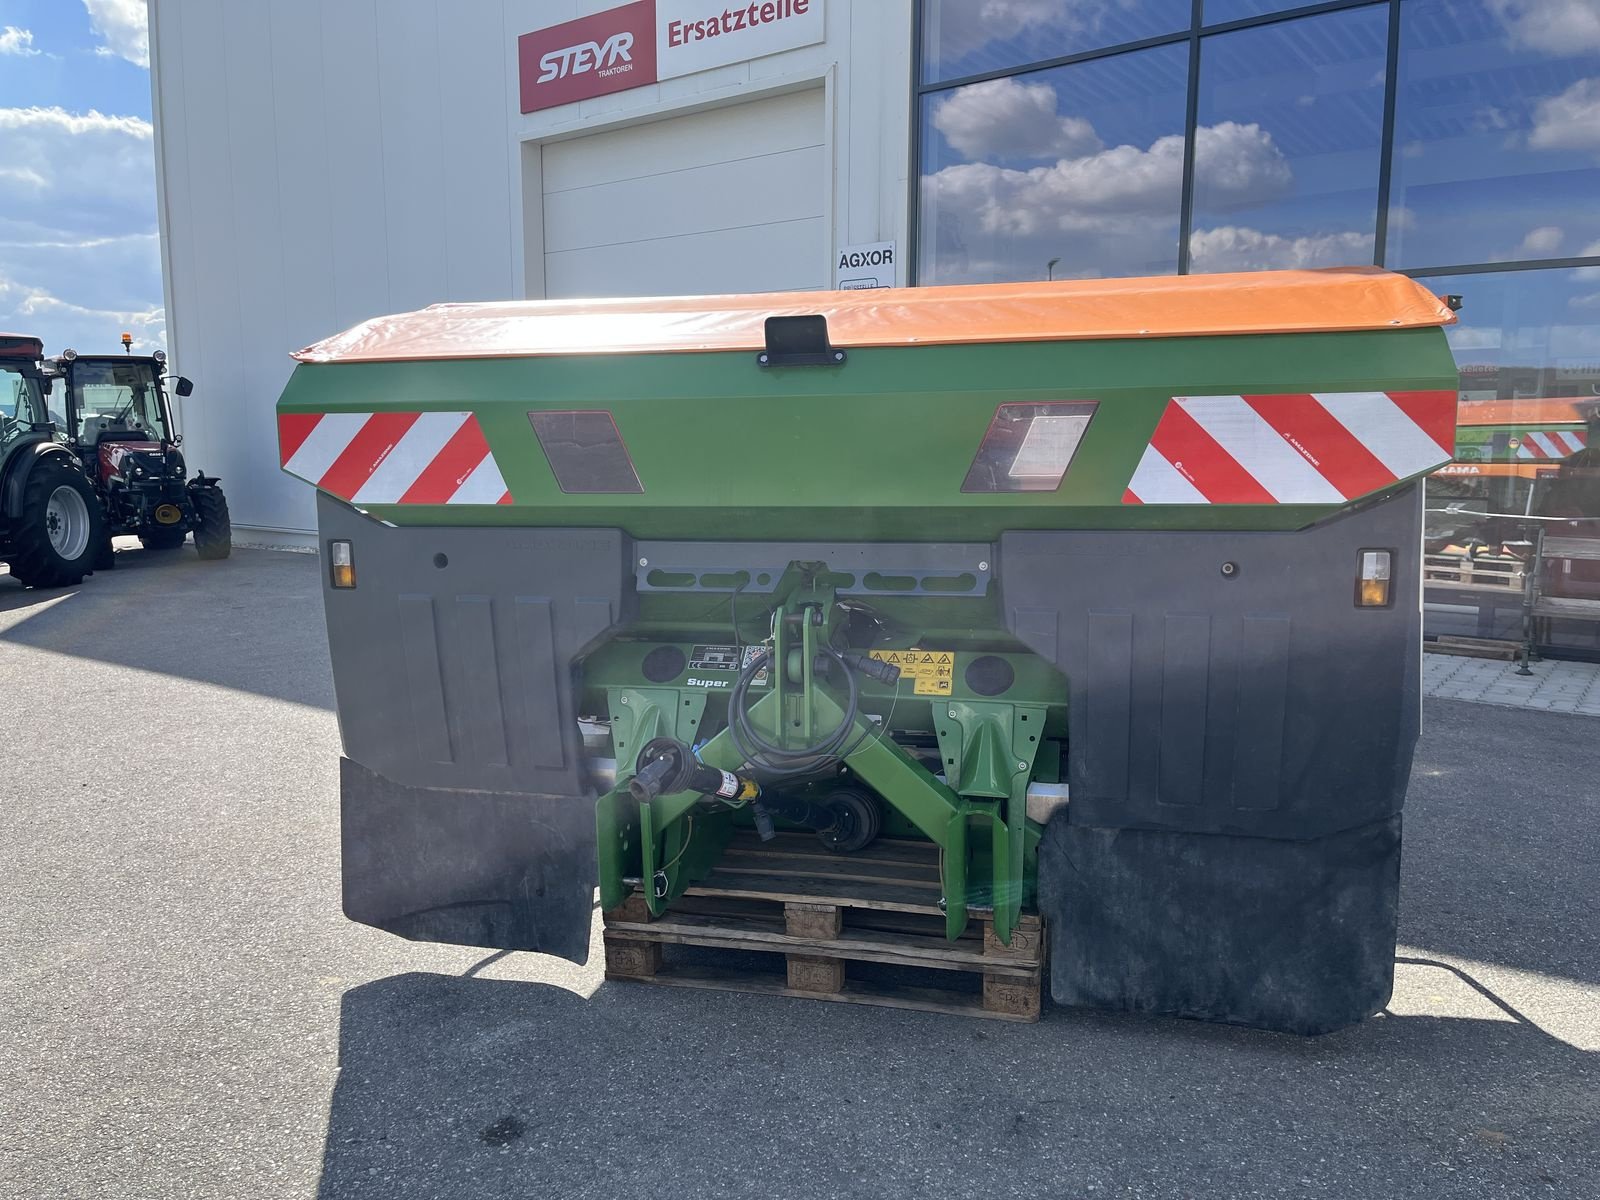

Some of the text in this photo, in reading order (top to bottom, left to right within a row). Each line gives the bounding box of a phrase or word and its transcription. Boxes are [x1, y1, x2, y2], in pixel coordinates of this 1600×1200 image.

[668, 0, 809, 48] Ersatzteile
[537, 32, 634, 84] STEYR
[598, 64, 633, 78] TRAKTOREN
[838, 249, 893, 269] AGXOR
[1290, 438, 1321, 467] AMAZONE
[687, 678, 729, 688] Super
